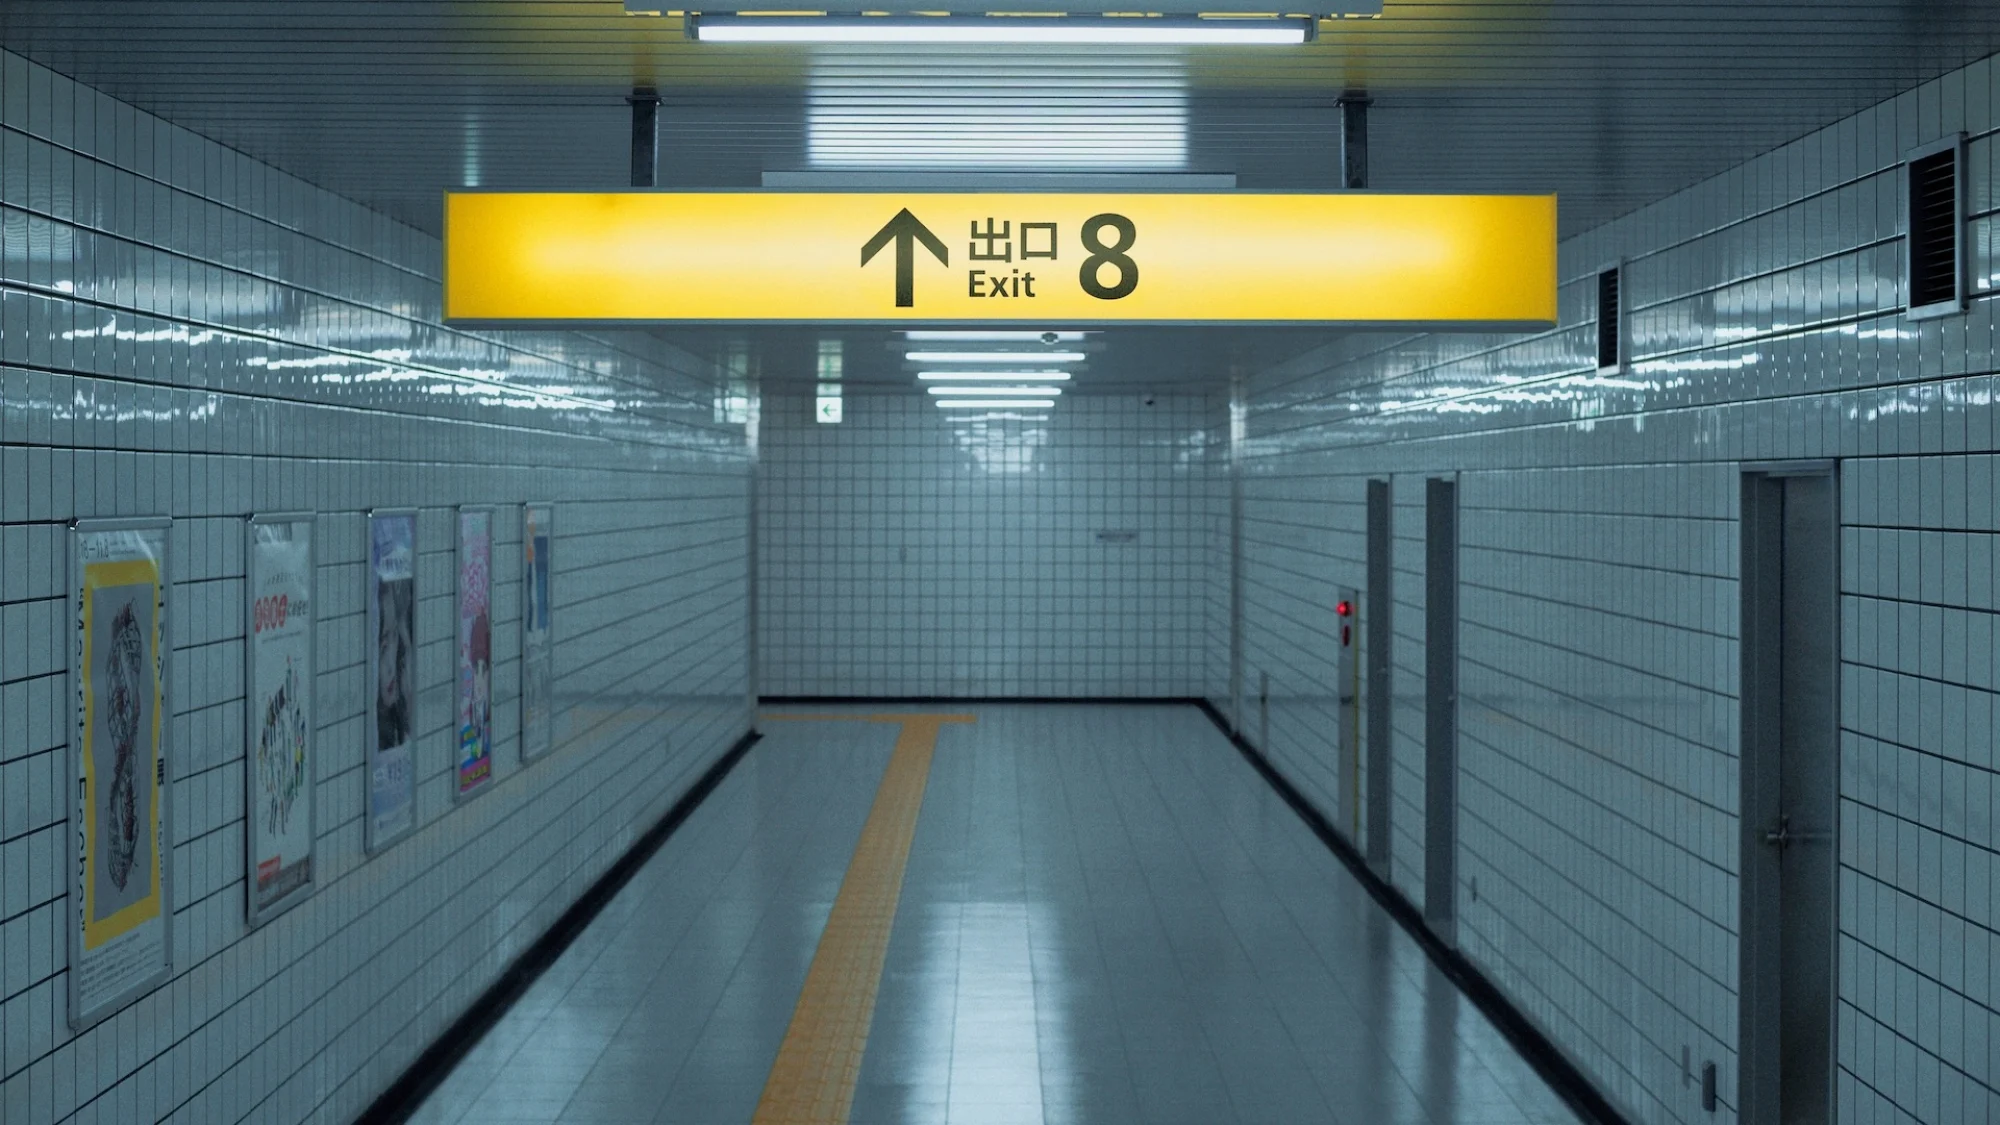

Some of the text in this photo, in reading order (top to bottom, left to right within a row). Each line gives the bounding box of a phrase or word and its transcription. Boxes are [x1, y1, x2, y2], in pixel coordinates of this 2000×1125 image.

[969, 217, 1058, 263] 出口
[1079, 213, 1139, 300] 8
[968, 268, 1036, 298] Exit
